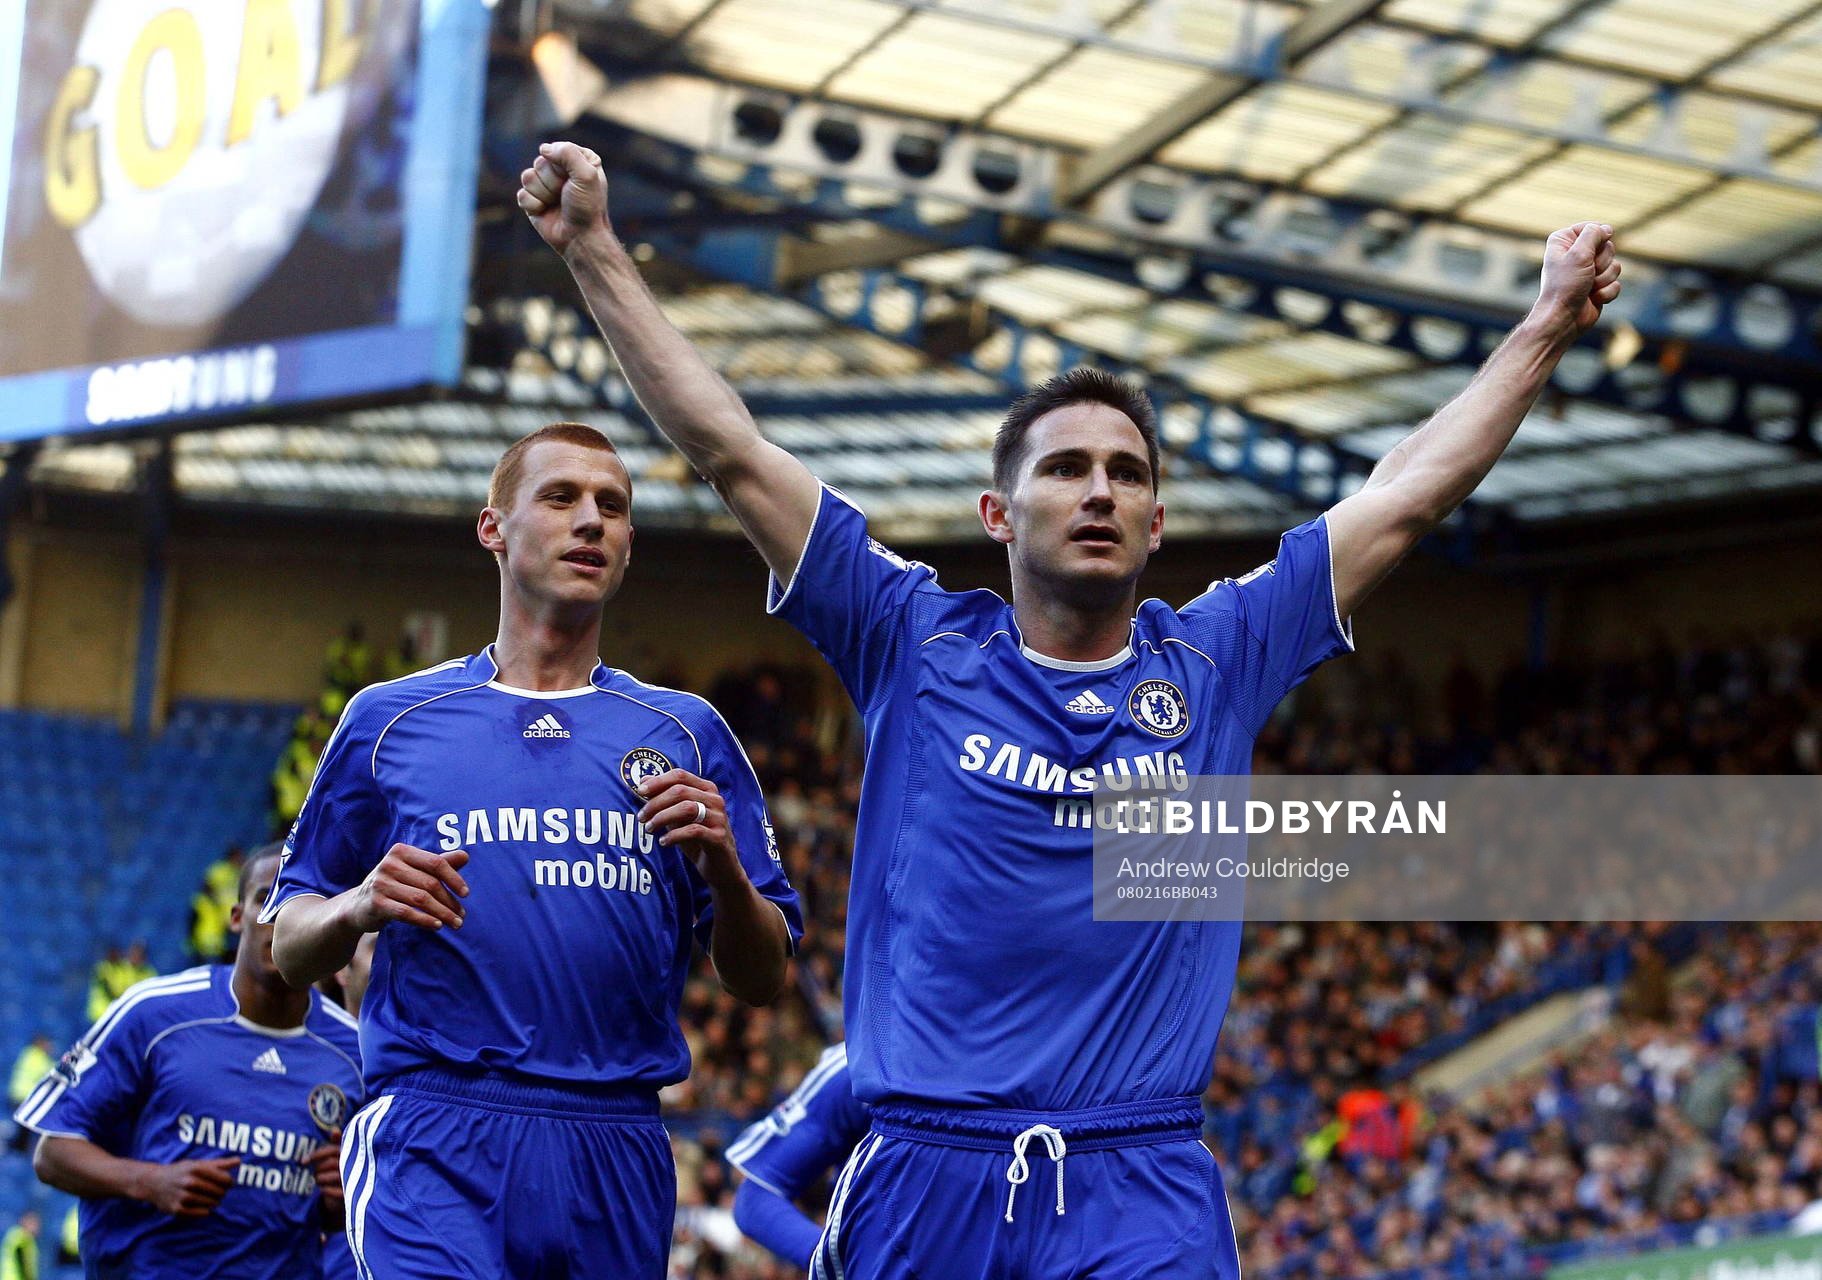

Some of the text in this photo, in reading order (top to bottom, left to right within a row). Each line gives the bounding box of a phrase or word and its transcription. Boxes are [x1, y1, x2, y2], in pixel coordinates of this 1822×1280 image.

[47, 0, 360, 228] GOAL
[1137, 683, 1174, 697] CHELSEA
[1065, 704, 1115, 714] adidas
[522, 728, 571, 739] adidas
[632, 751, 666, 768] CHELSEA
[959, 733, 1189, 793] SAMSUNG
[534, 852, 653, 895] mobile
[178, 1113, 317, 1163] SAMSUN
